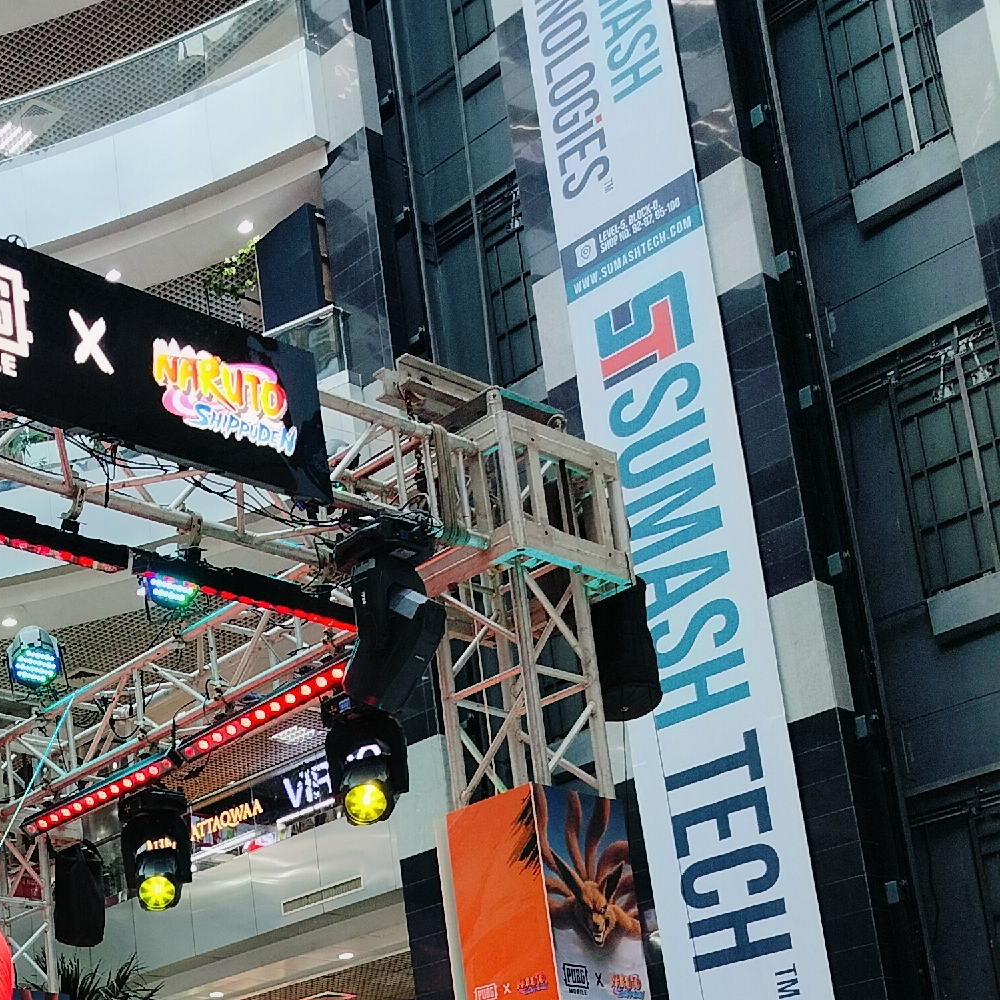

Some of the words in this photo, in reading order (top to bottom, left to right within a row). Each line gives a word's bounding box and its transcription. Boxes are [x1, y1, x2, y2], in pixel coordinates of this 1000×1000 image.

[573, 215, 692, 295] WWW.SUMASHTECH.COM
[68, 308, 115, 376] X
[154, 350, 288, 421] NARUTO
[188, 402, 297, 456] SHIPPUDEN
[608, 361, 752, 731] SUMASH
[660, 728, 795, 974] TECH
